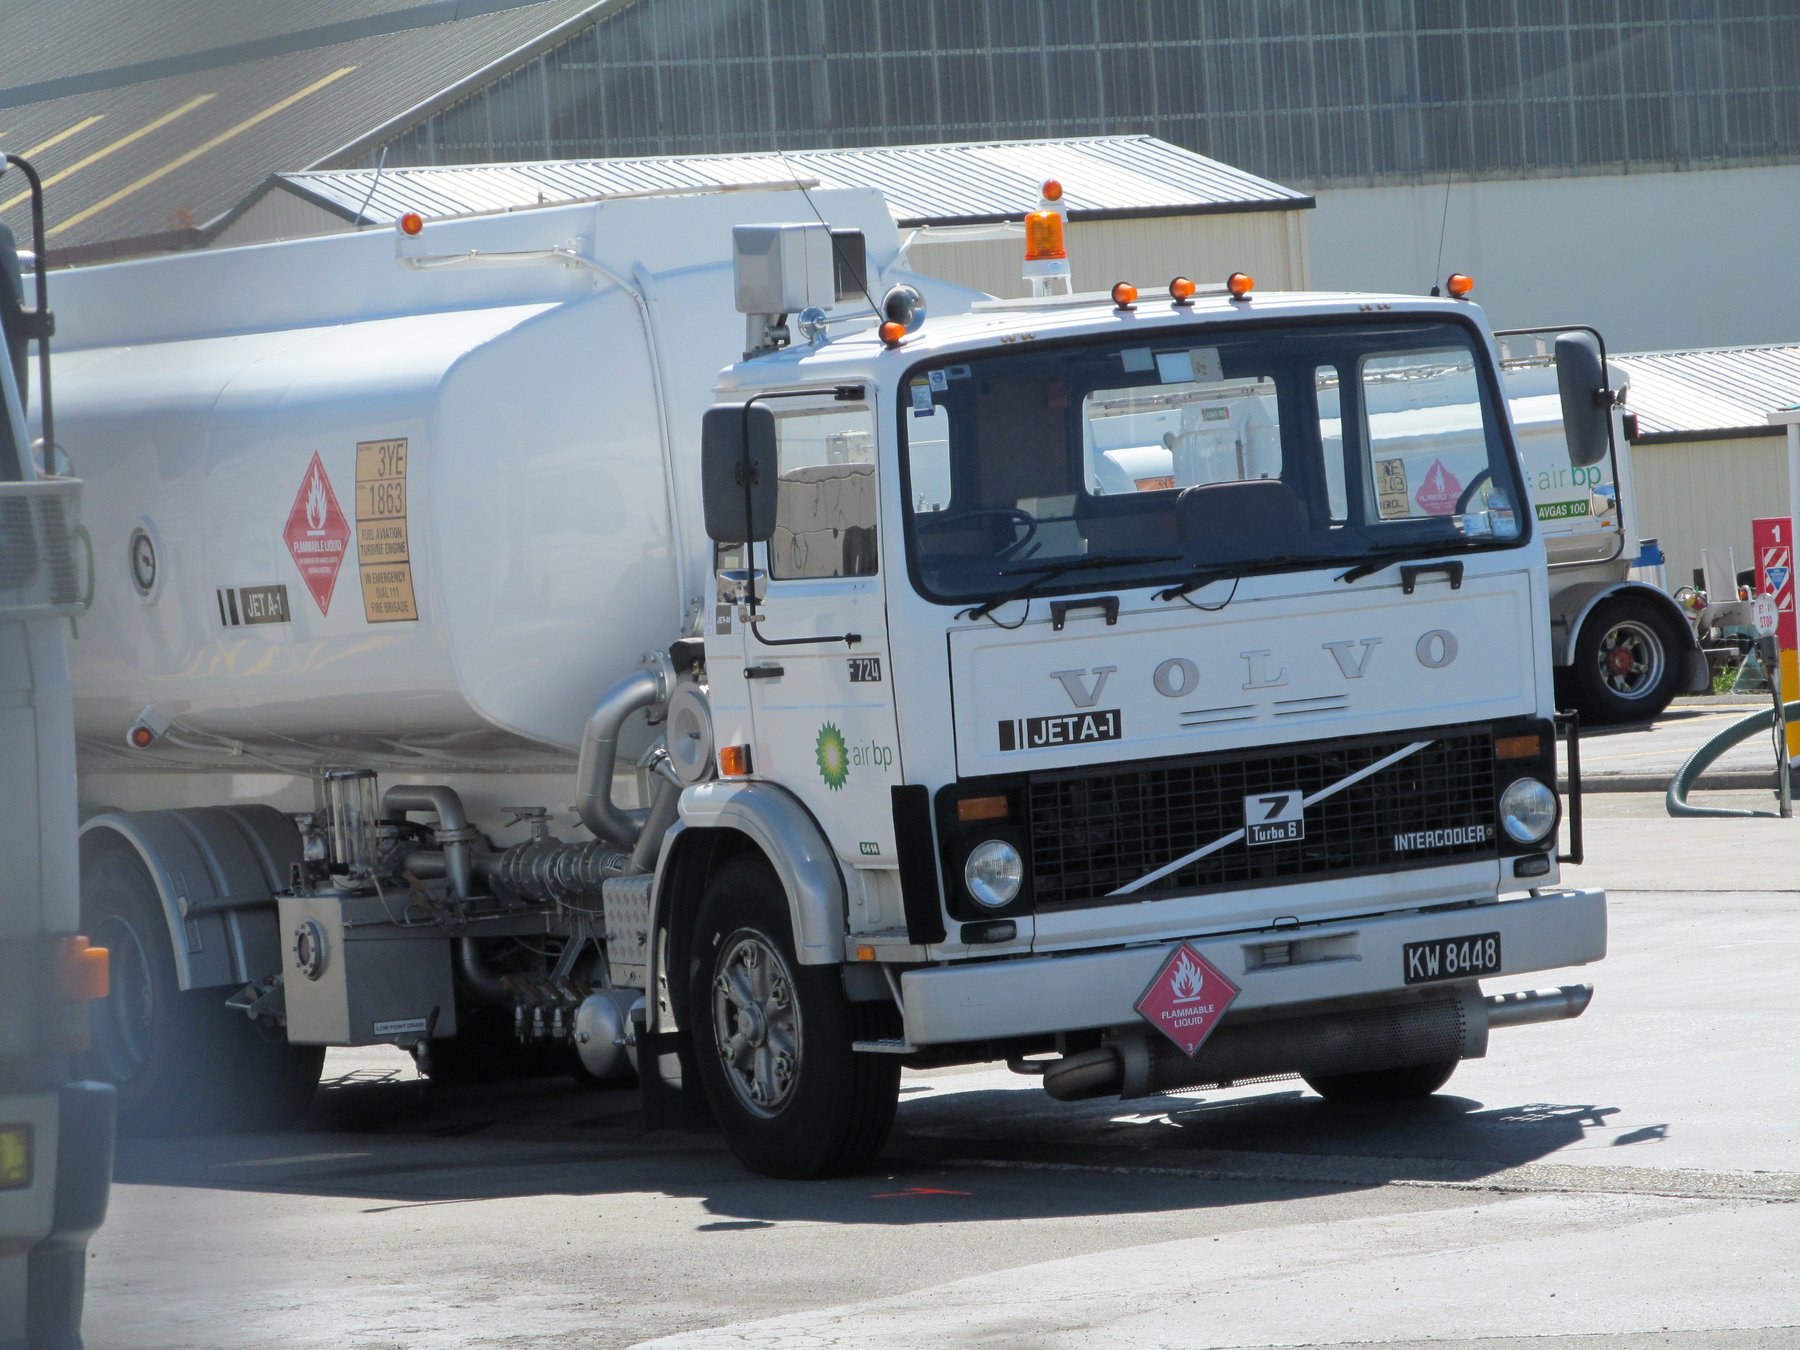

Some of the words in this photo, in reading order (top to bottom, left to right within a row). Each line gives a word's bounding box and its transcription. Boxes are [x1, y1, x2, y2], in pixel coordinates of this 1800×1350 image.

[378, 443, 403, 477] 3YE
[370, 483, 402, 515] 1863
[1538, 504, 1568, 518] AVGAS
[1570, 502, 1586, 514] 100
[361, 528, 375, 540] FUEL
[376, 527, 402, 540] AVIATION
[1772, 525, 1781, 542] 1
[293, 540, 324, 553] FLAMMABLE
[360, 543, 384, 556] TURBINE
[385, 541, 406, 554] ENGINE
[365, 573, 372, 584] IN
[372, 571, 406, 584] EMERGENCY
[376, 587, 389, 599] DIAL
[390, 587, 400, 598] 111
[248, 593, 265, 617] JET
[268, 592, 283, 616] A-1
[371, 602, 384, 613] FIRE
[384, 600, 409, 613] BRIGADE
[1760, 615, 1773, 629] STOP
[1050, 629, 1459, 707] VOLVO
[1259, 795, 1290, 820] 7
[1253, 825, 1285, 841] Turbo
[1288, 821, 1297, 837] 6
[1394, 825, 1486, 851] INTERCOOLER
[1409, 945, 1440, 978] KW
[1446, 938, 1497, 973] 8448
[1161, 1004, 1215, 1019] FLAMMABLE
[1174, 1016, 1203, 1028] LIQUID
[1188, 1043, 1193, 1051] 3
